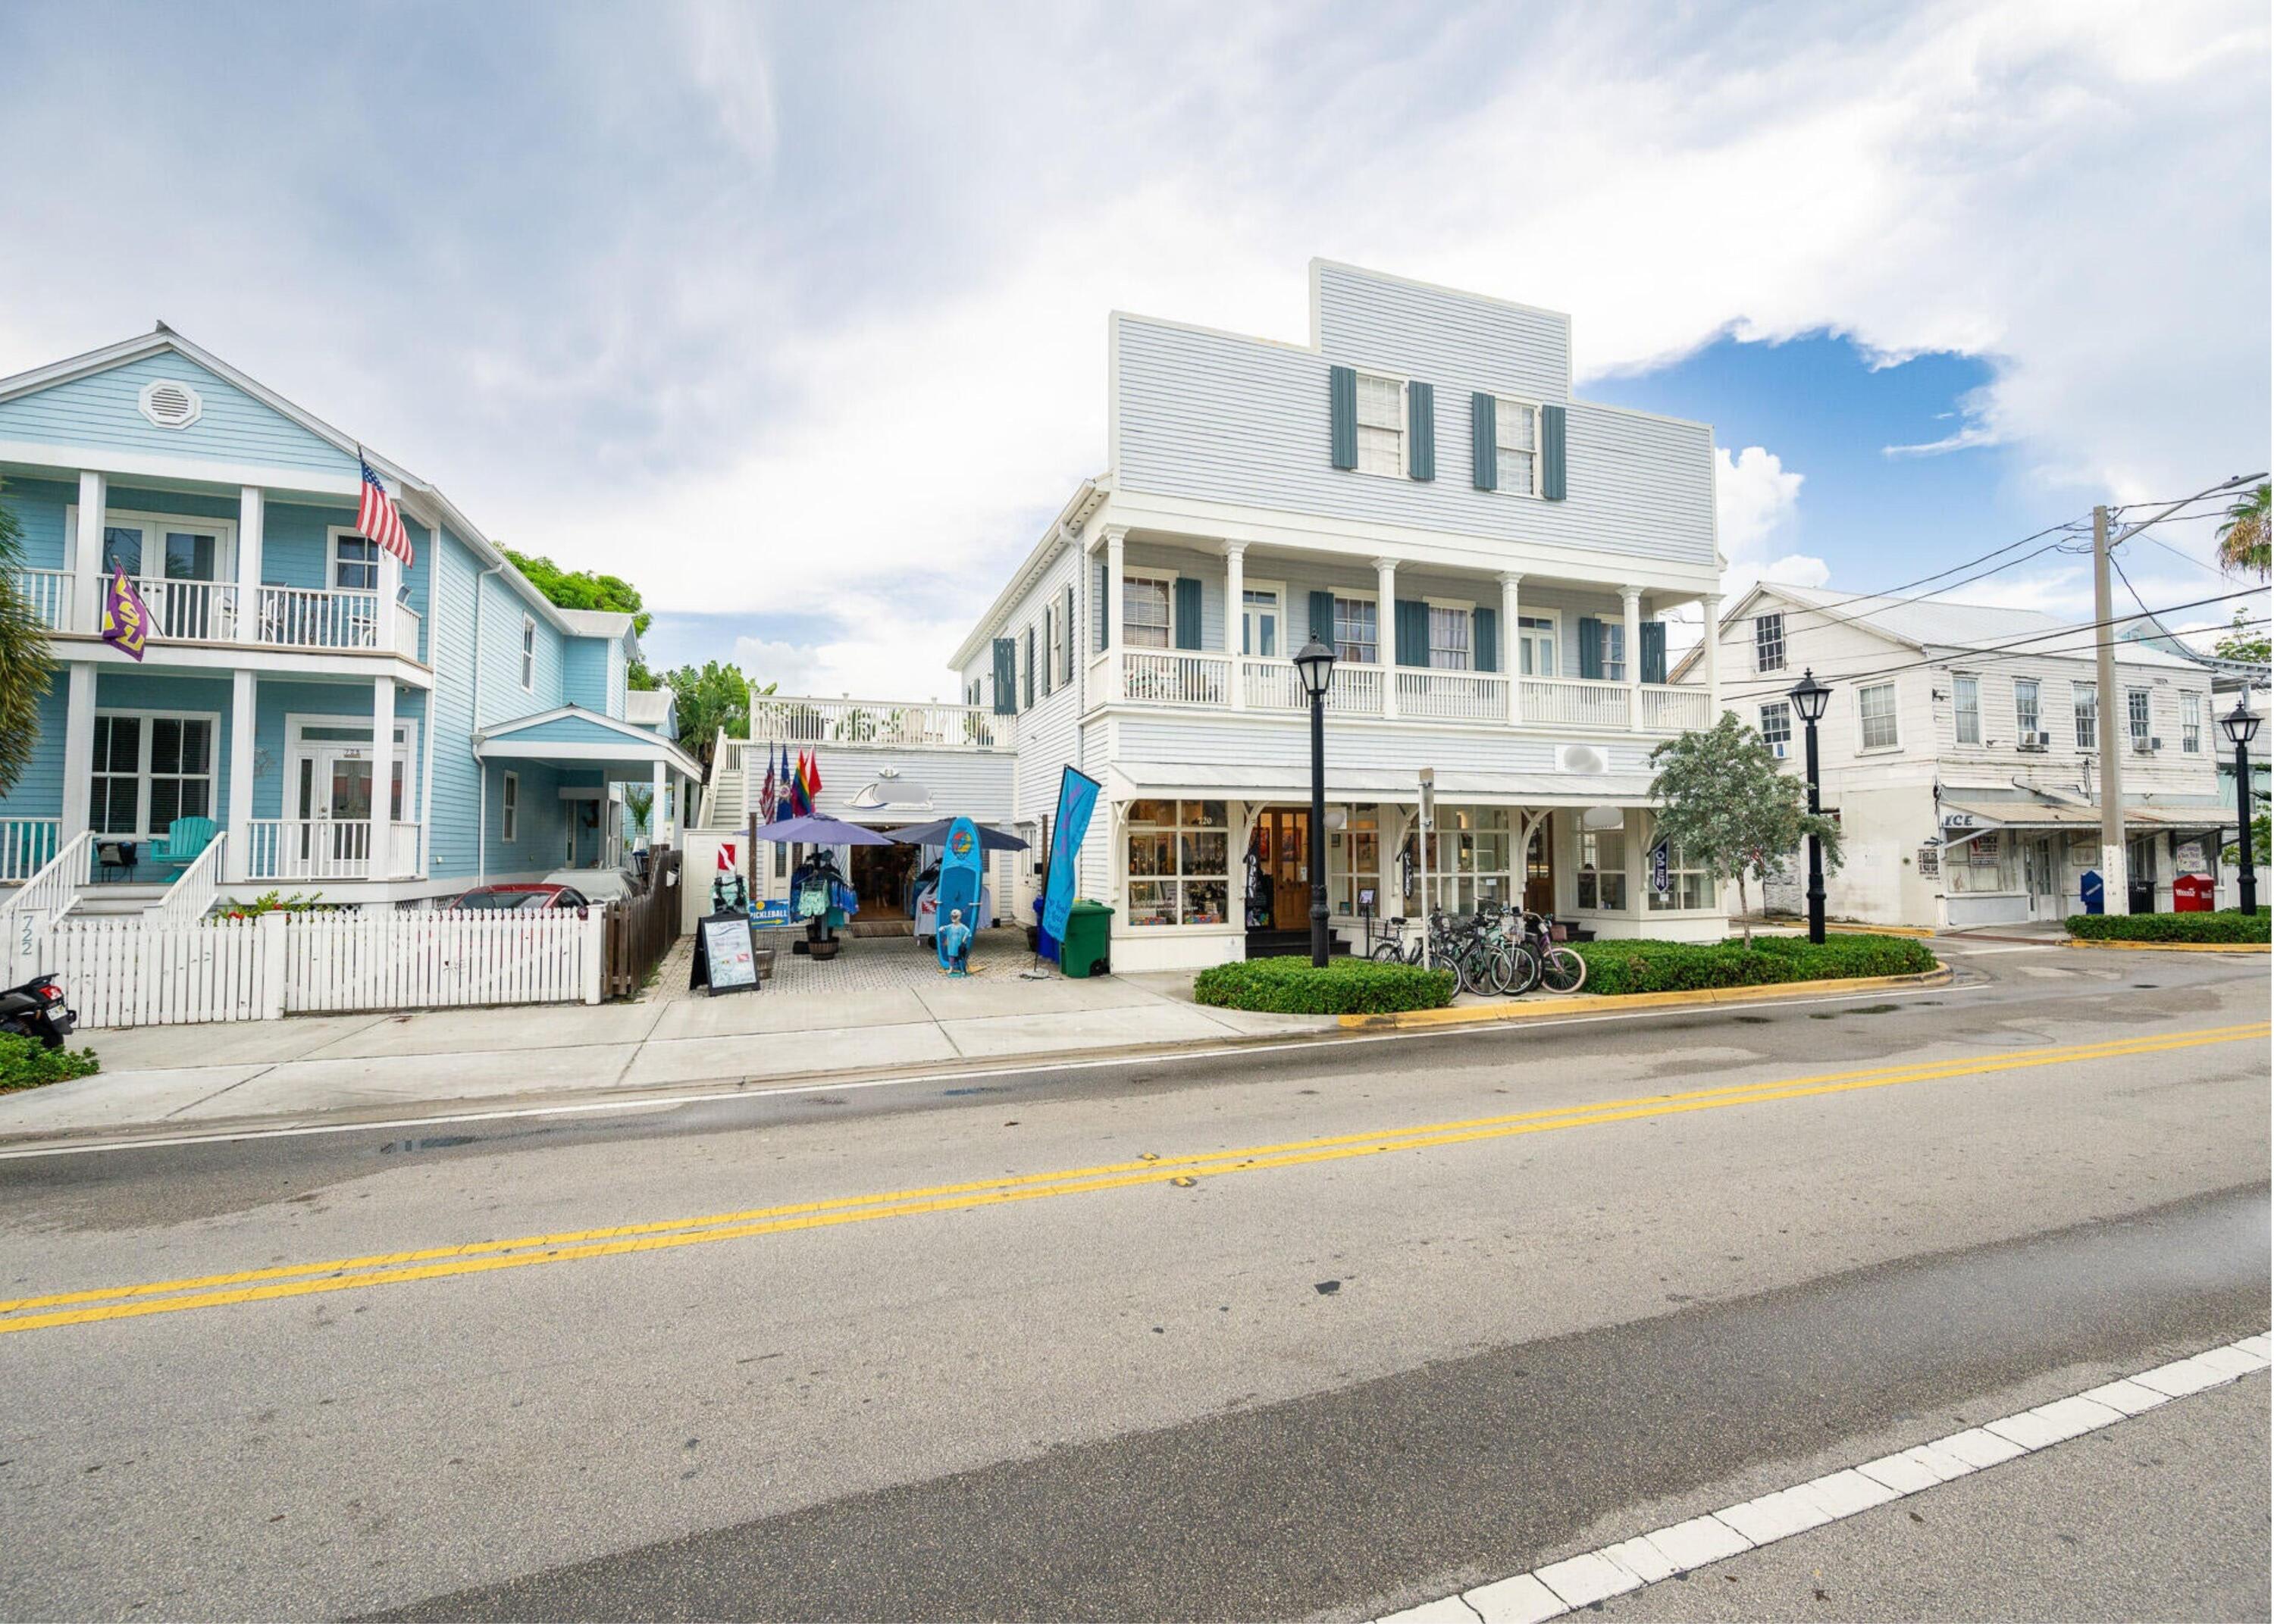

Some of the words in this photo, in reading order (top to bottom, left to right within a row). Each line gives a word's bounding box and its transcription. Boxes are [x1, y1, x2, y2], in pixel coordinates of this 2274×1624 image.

[115, 574, 146, 652] LSU
[1655, 850, 1666, 887] OPEN
[750, 909, 788, 919] PICKLEBALL
[21, 915, 34, 956] 722
